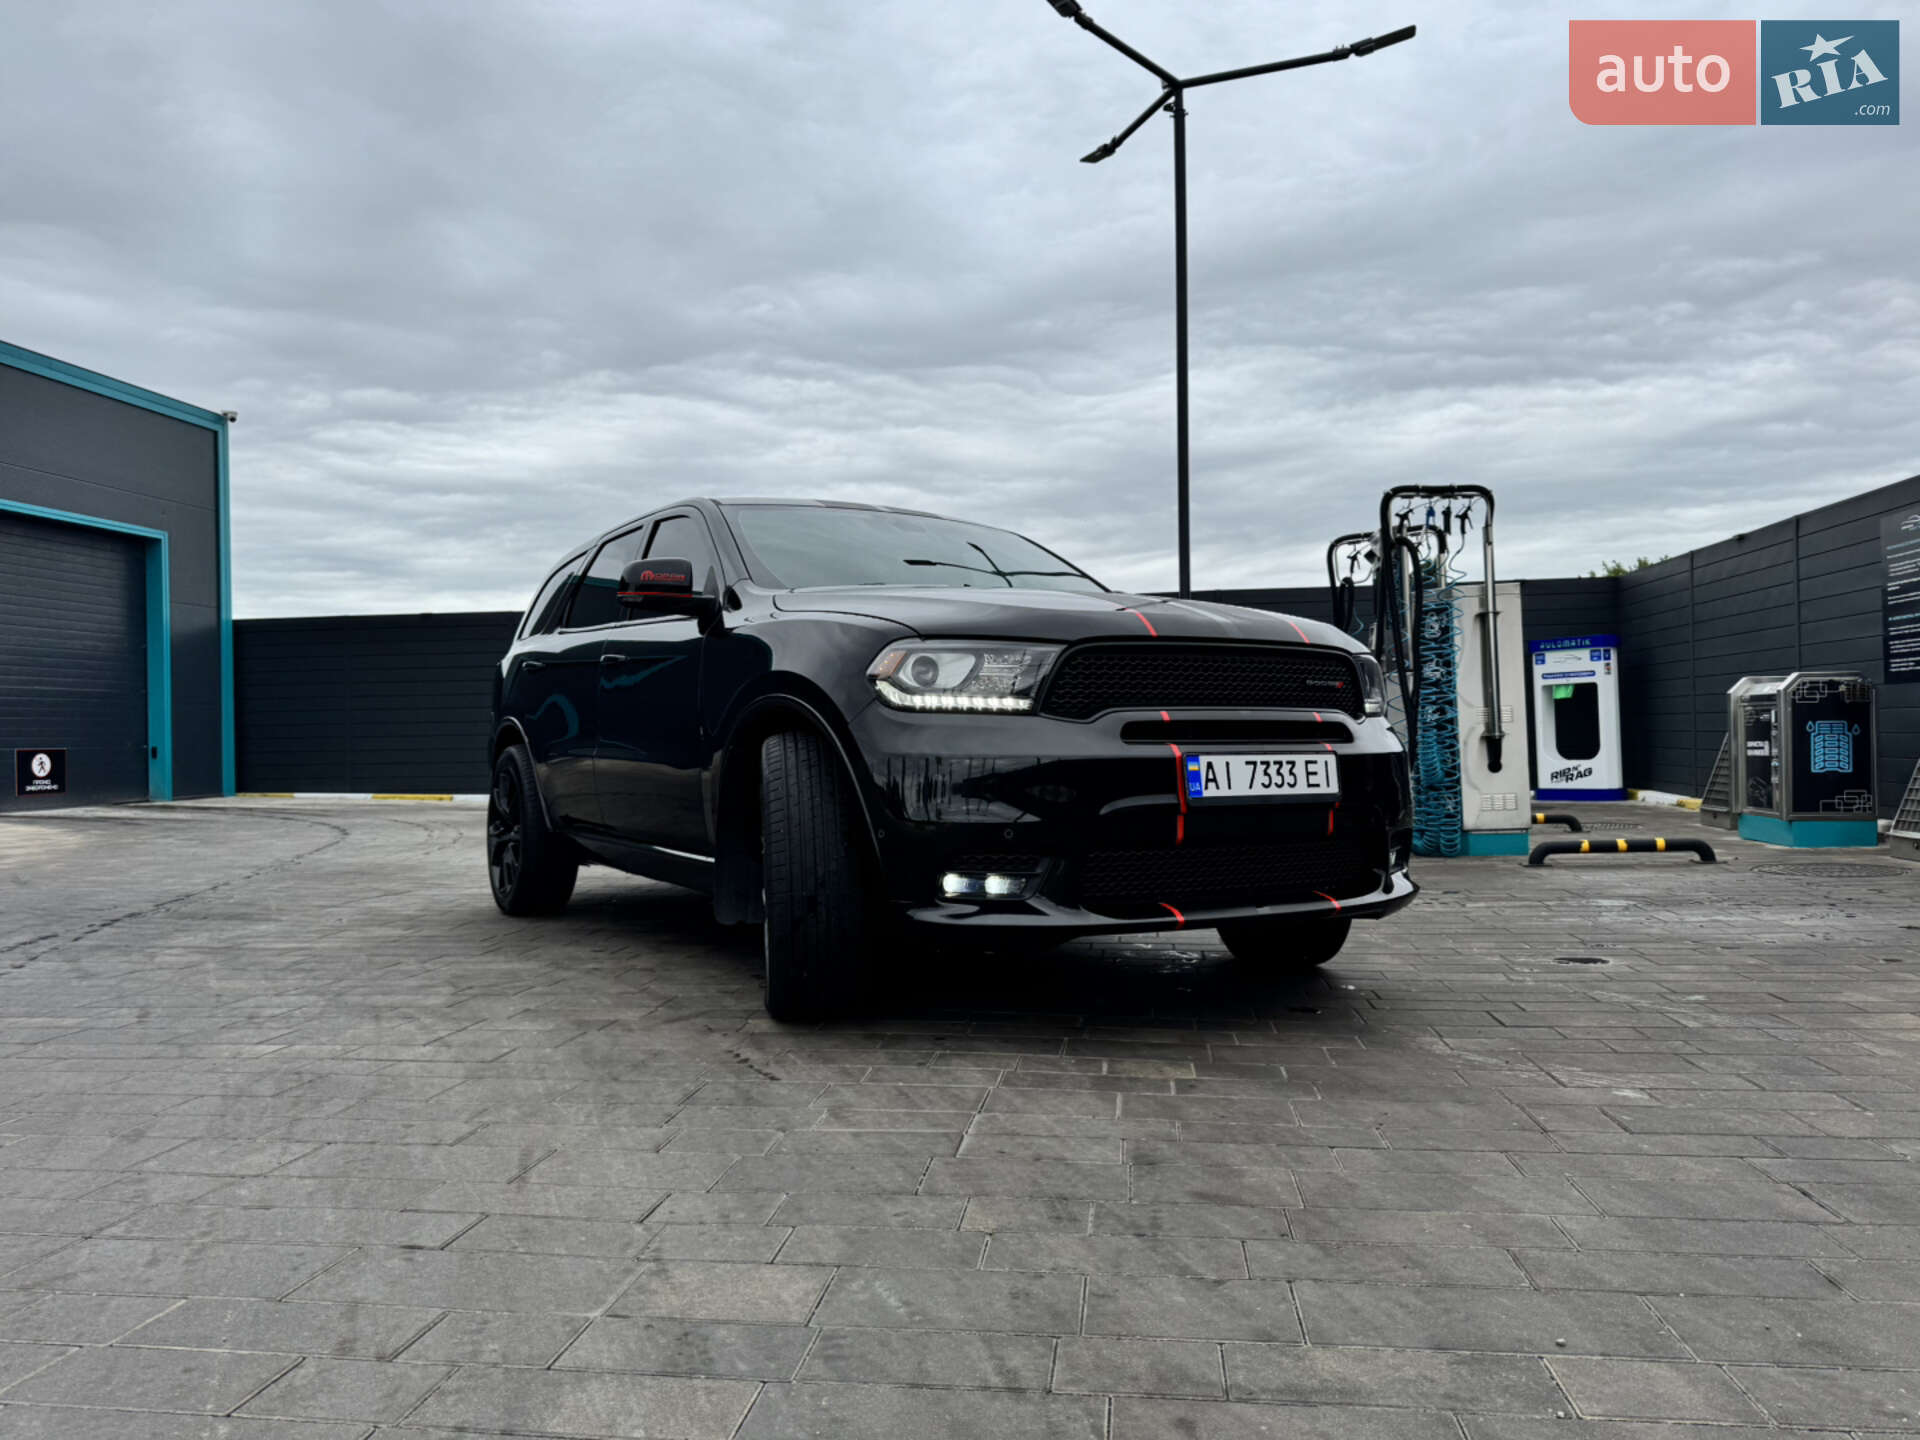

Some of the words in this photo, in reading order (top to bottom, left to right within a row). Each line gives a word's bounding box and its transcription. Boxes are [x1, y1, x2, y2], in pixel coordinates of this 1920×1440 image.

[1204, 760, 1232, 790] AI
[1245, 760, 1298, 790] 7333
[1305, 760, 1331, 788] EI
[1550, 767, 1572, 782] RIP
[1565, 767, 1593, 783] RAG
